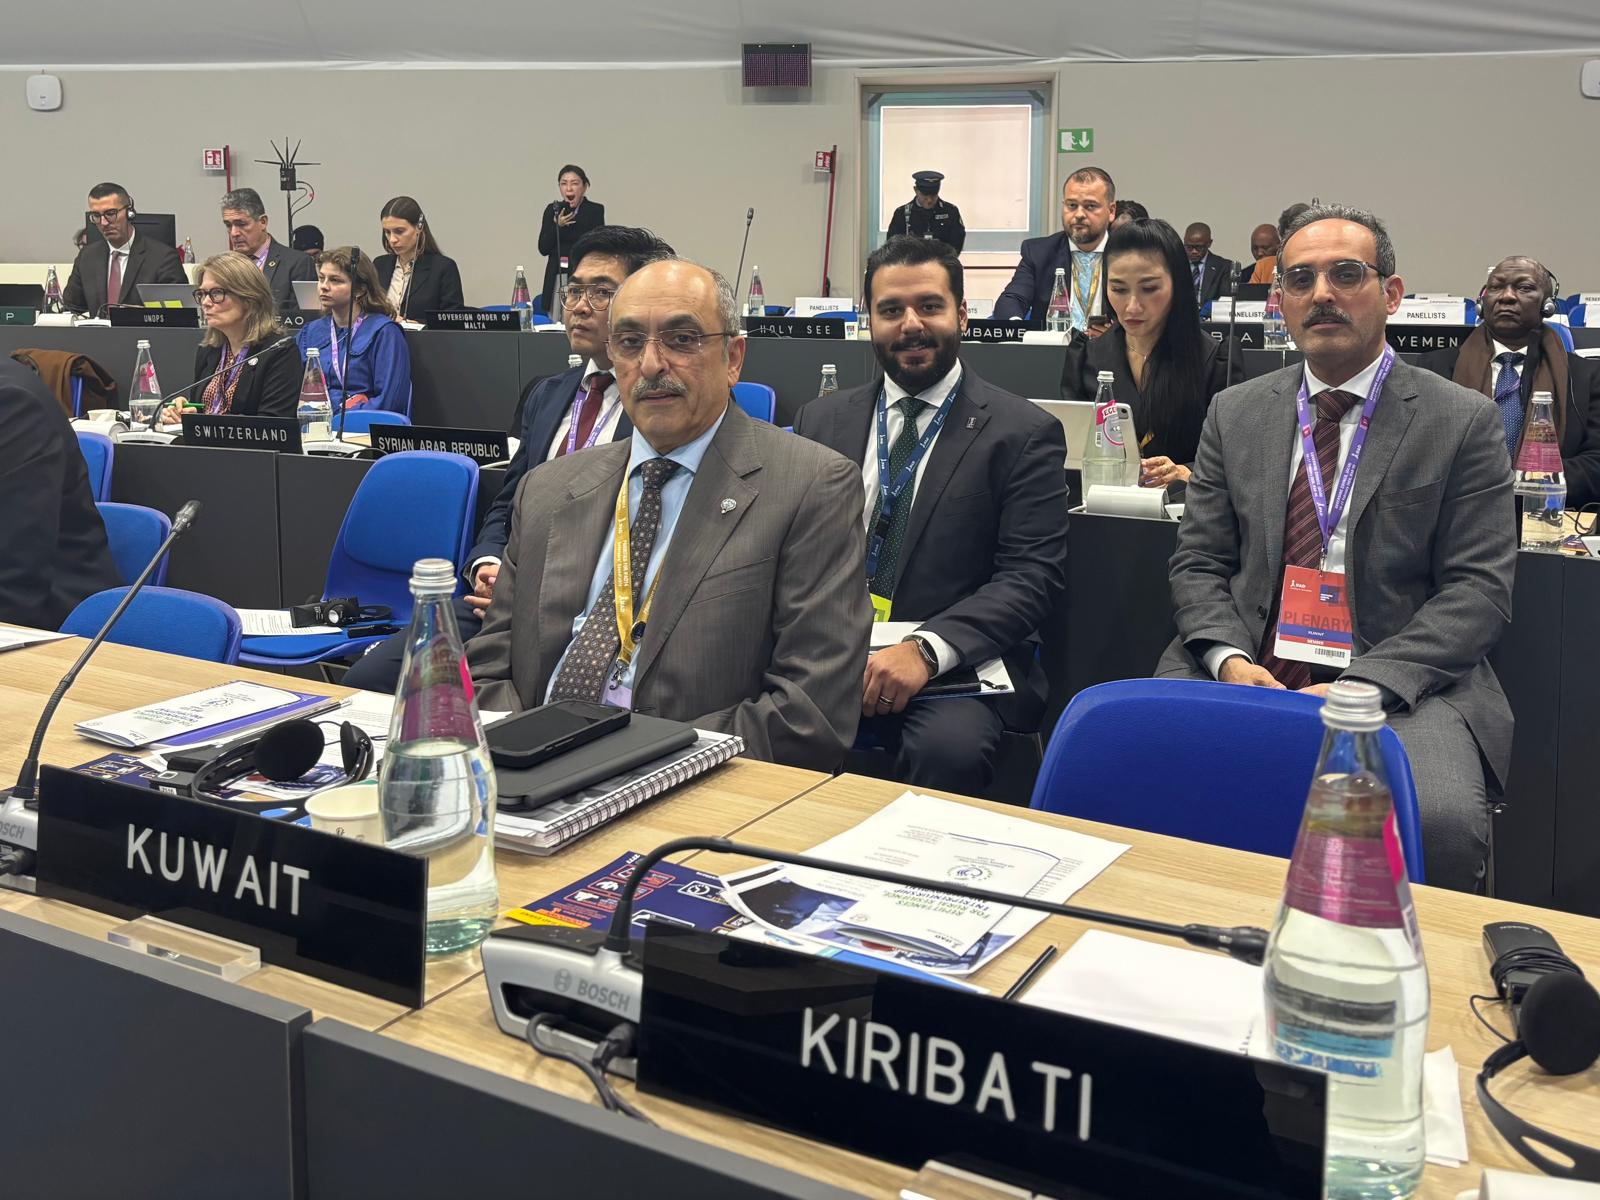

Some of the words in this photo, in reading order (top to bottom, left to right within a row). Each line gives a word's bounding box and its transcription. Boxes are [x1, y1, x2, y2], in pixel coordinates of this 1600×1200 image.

[144, 314, 164, 322] UNOPS
[760, 325, 793, 335] HOLY
[806, 325, 830, 335] SEE
[1397, 335, 1458, 348] YEMEN
[194, 424, 288, 442] SWITZERLAND
[378, 436, 414, 451] SYRIAN
[420, 440, 446, 452] ARAB
[451, 442, 500, 458] REPUBLIC
[1284, 610, 1350, 632] PLENARY
[126, 823, 310, 916] KUWAIT
[577, 978, 630, 1012] BOSCH
[800, 1008, 1092, 1142] KIRIBATI
